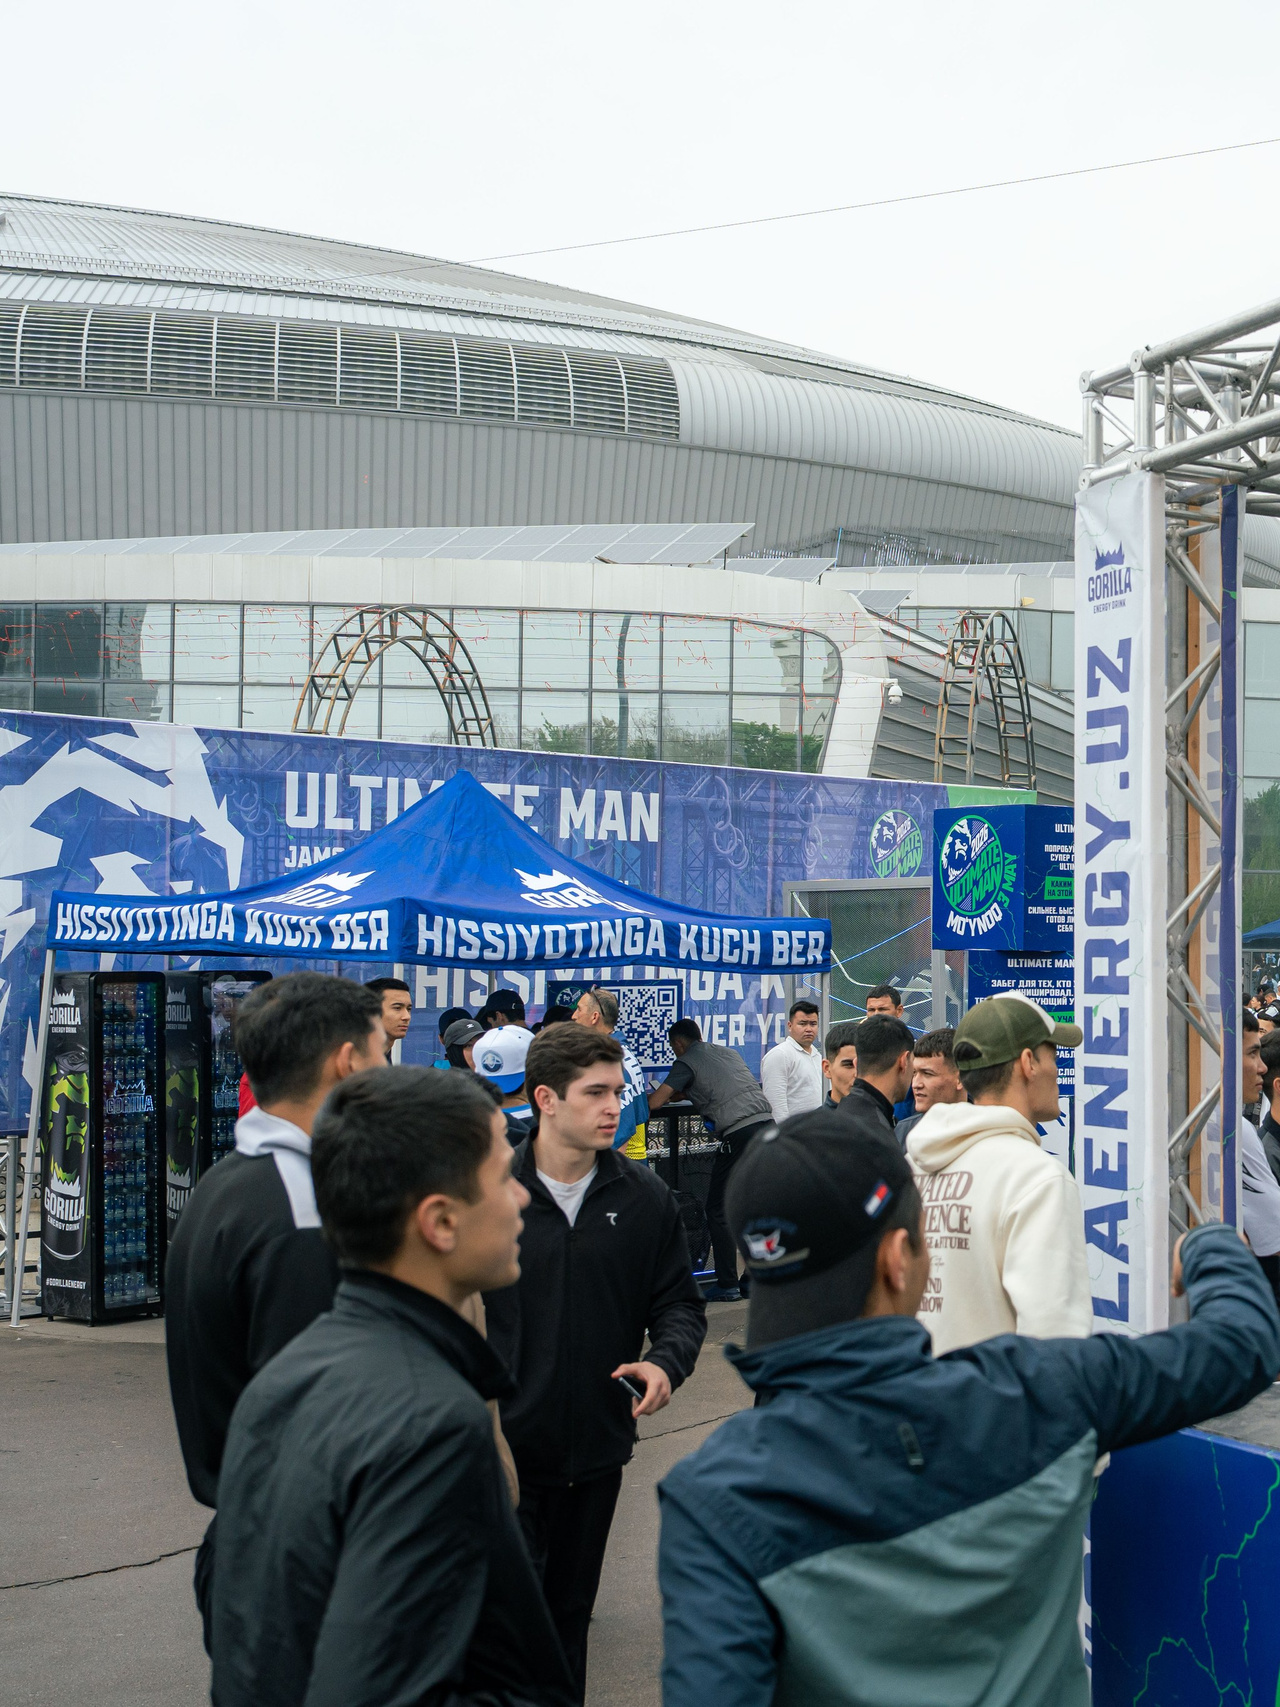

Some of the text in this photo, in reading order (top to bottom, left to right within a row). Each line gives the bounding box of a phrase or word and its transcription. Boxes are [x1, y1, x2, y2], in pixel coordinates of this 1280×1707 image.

[1088, 566, 1132, 602] GORILLA
[1093, 599, 1126, 614] ENERGY DRINK
[560, 786, 660, 843] MAN
[971, 823, 988, 859] 2026
[1045, 845, 1075, 853] ПОПРОБУ
[949, 843, 1000, 905] ULTIMATE
[972, 863, 1000, 911] MAN
[1002, 852, 1017, 892] MAY
[55, 901, 389, 951] HISSIYOTINGA KUCH BER
[417, 914, 826, 966] HISSIYOTINGA KUCH BER
[1007, 958, 1075, 968] ULTIMATE MAN
[991, 979, 1016, 987] ЗАБЕГ
[1018, 980, 1036, 988] ДЛЯ
[1084, 637, 1133, 1326] LAENERGY.UZ
[106, 1095, 154, 1115] GORILLA
[44, 1186, 85, 1221] GORILLA
[47, 1215, 80, 1231] ENERGY DRINK
[46, 1278, 87, 1290] #GORILLAENERGY
